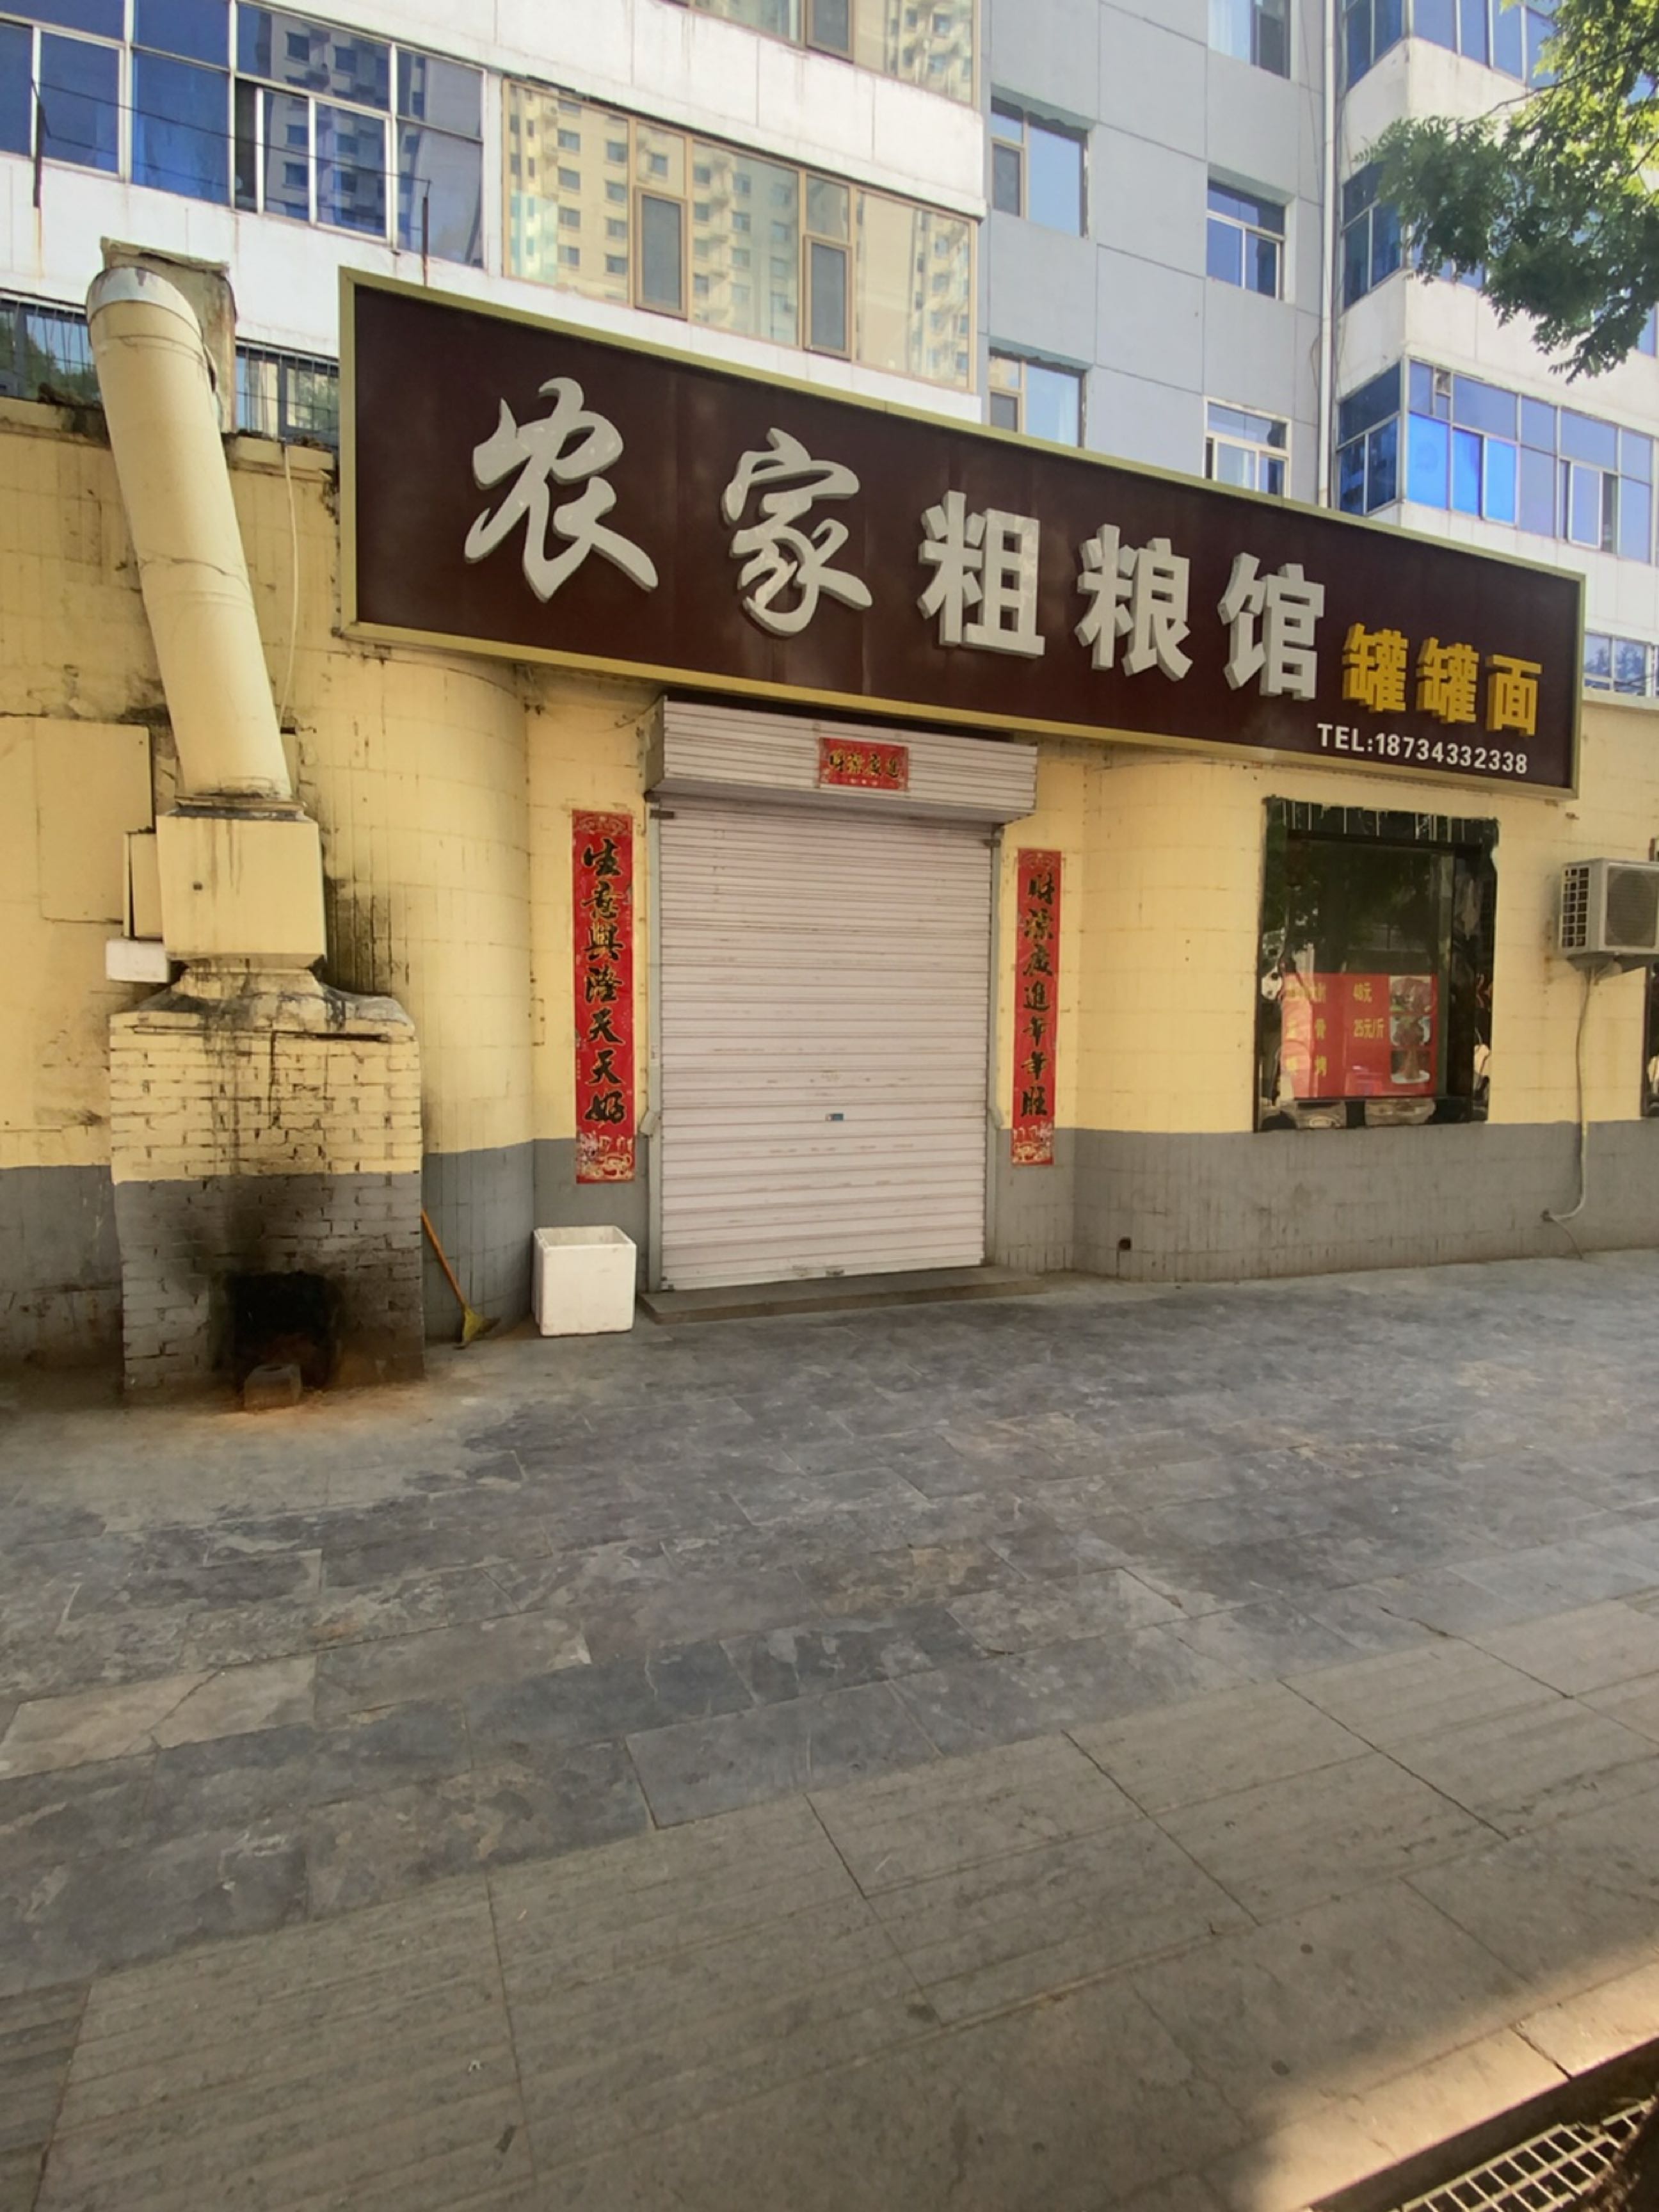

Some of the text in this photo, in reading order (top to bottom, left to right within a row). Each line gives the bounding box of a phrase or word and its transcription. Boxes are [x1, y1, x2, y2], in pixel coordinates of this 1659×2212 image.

[464, 376, 1325, 701] 农家粗粮馆
[1342, 622, 1541, 737] 罐罐面
[1317, 723, 1528, 775] TEL:18734332338
